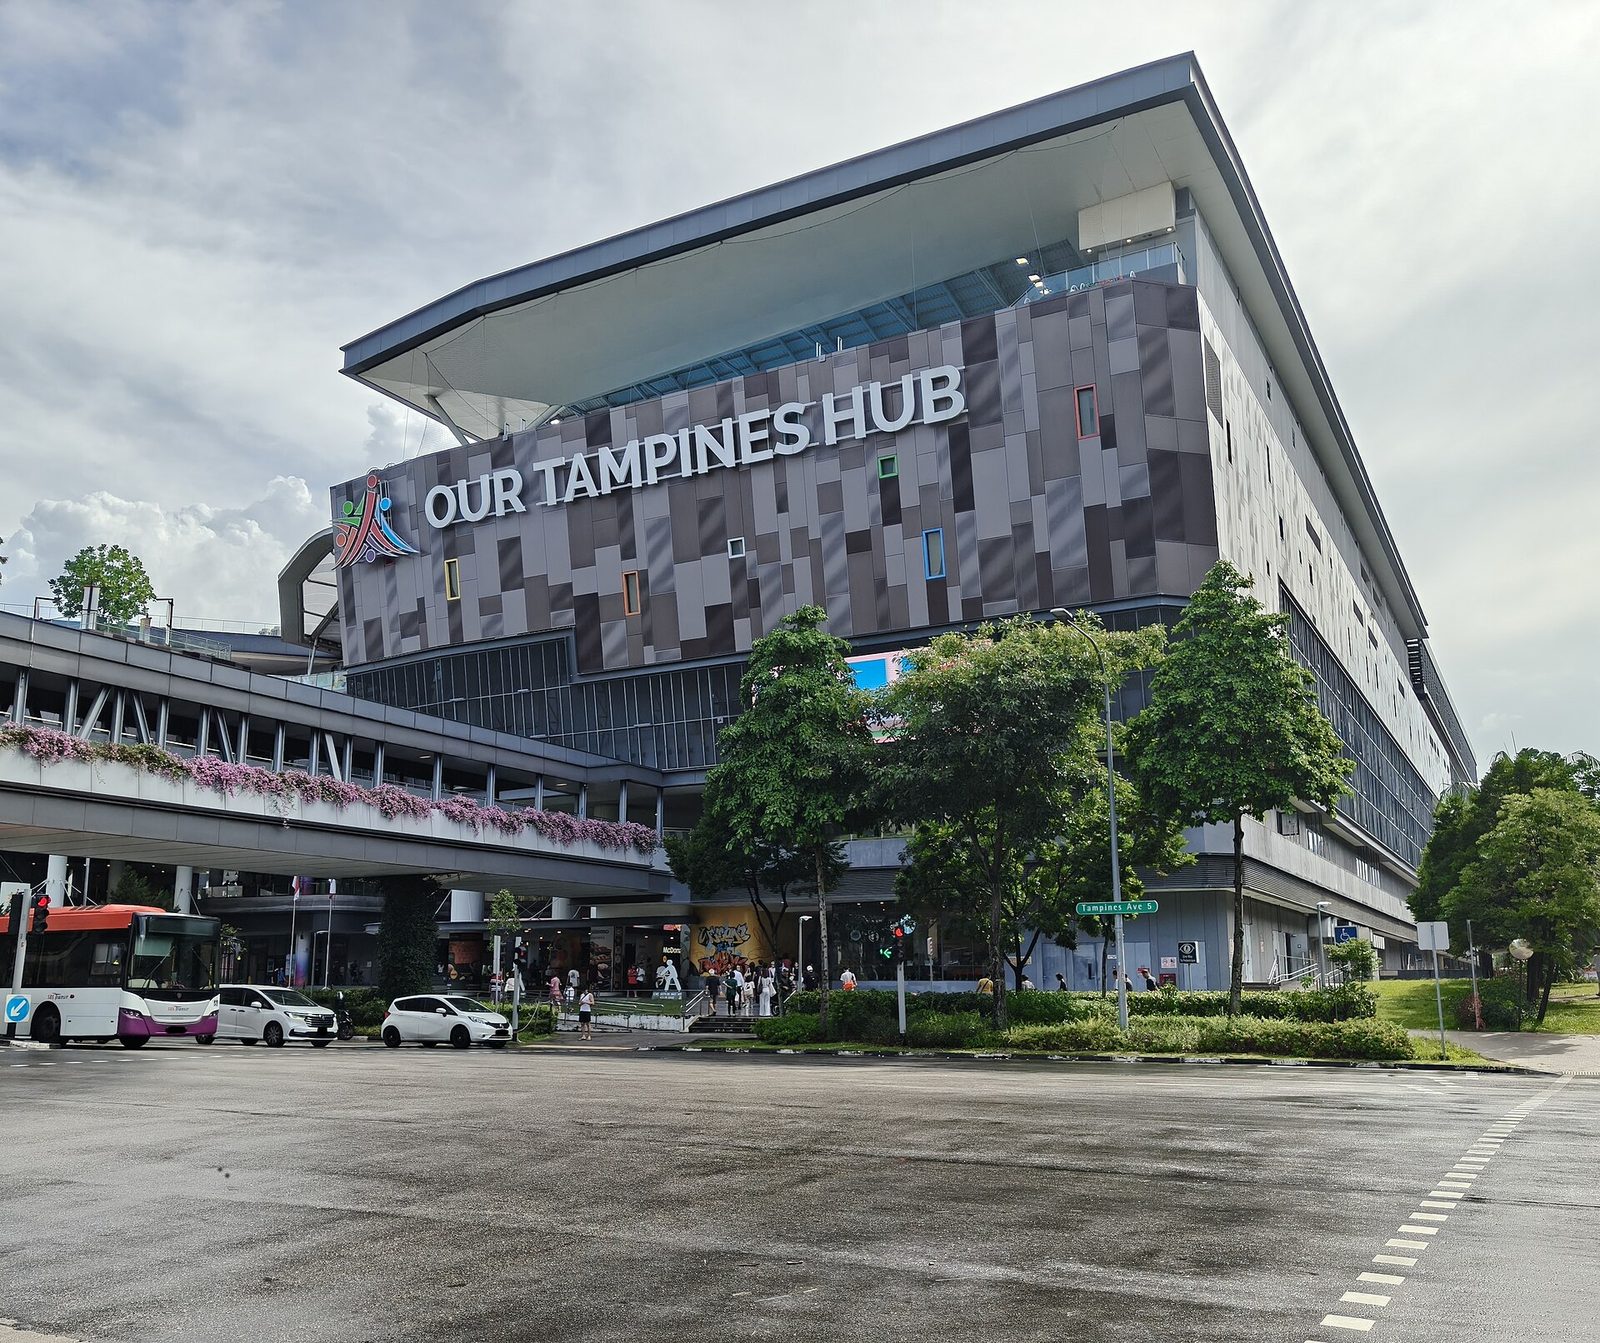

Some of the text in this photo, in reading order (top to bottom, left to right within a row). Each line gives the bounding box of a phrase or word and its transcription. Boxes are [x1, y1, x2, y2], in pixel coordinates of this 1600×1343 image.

[424, 364, 967, 529] OUR TAMPINES HUB
[1082, 902, 1152, 913] Tampines Ave 5
